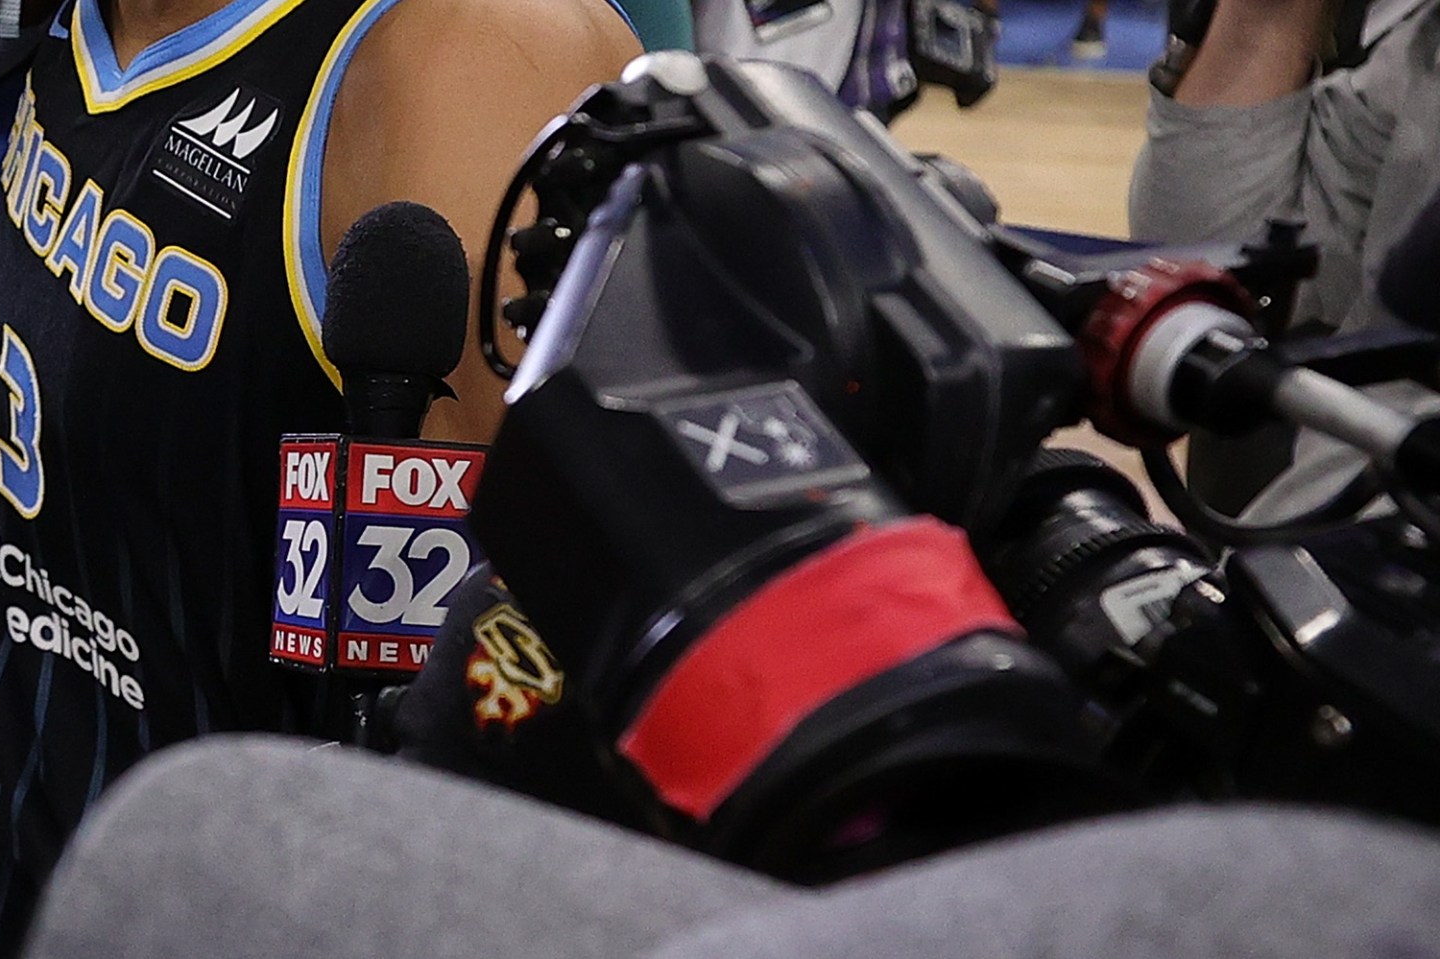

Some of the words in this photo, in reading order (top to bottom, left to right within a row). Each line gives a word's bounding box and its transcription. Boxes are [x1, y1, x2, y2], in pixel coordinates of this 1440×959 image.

[164, 134, 248, 193] MAGELLAN
[285, 452, 330, 501] FOX
[361, 453, 471, 510] FOX
[276, 520, 328, 619] 32
[347, 525, 470, 627] 32
[0, 543, 140, 662] Chicago
[5, 605, 145, 710] edicine
[274, 630, 322, 658] NEWS
[347, 640, 435, 663] NEW
